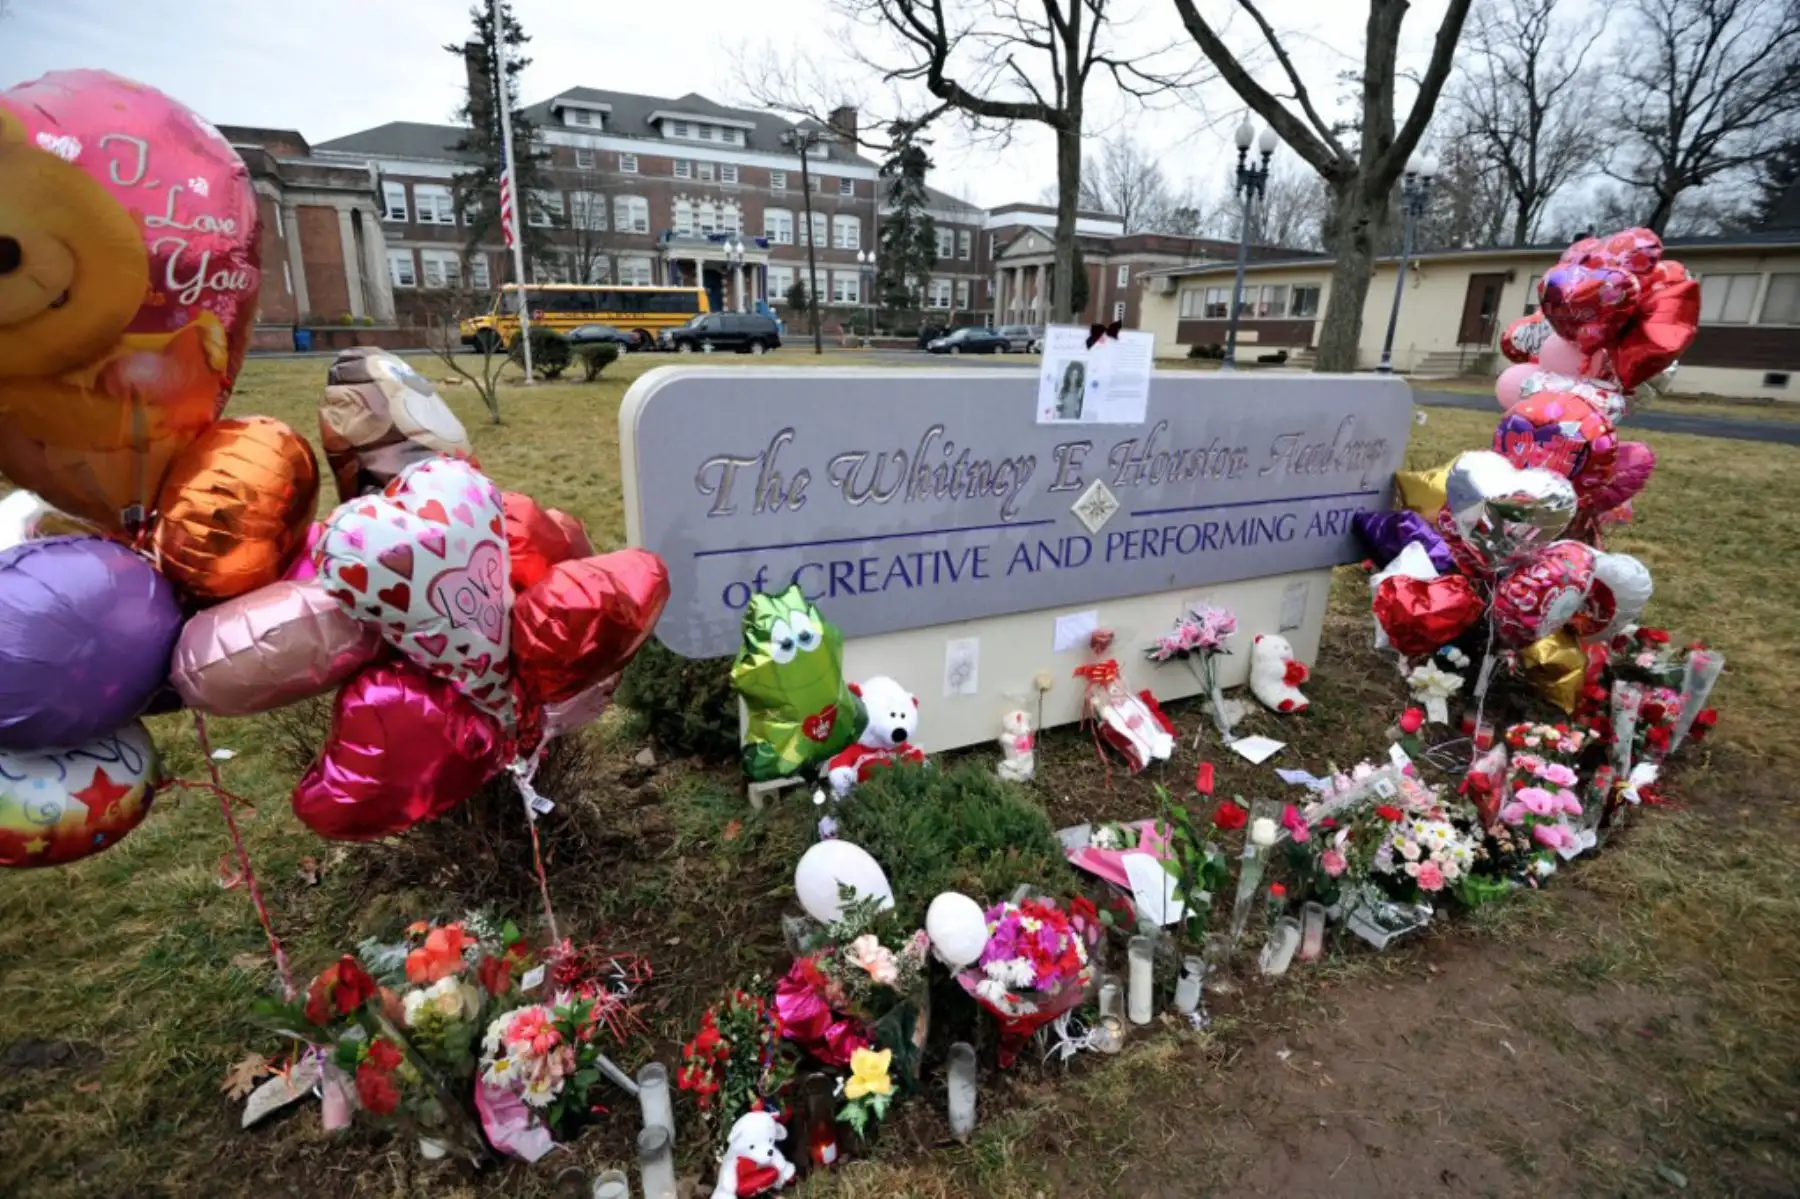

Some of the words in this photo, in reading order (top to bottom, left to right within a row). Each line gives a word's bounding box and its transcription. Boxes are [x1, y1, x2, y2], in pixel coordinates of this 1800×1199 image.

[144, 184, 237, 235] Love
[152, 235, 248, 305] You
[694, 426, 813, 518] The
[826, 423, 1038, 523] Whitney
[1047, 439, 1094, 494] E
[1106, 419, 1250, 488] Houston
[1257, 413, 1389, 493] Academy
[722, 564, 769, 610] of
[790, 544, 990, 601] CREATIVE
[1005, 535, 1093, 576] AND
[1104, 512, 1297, 563] PERFORMING
[1304, 506, 1366, 539] ART
